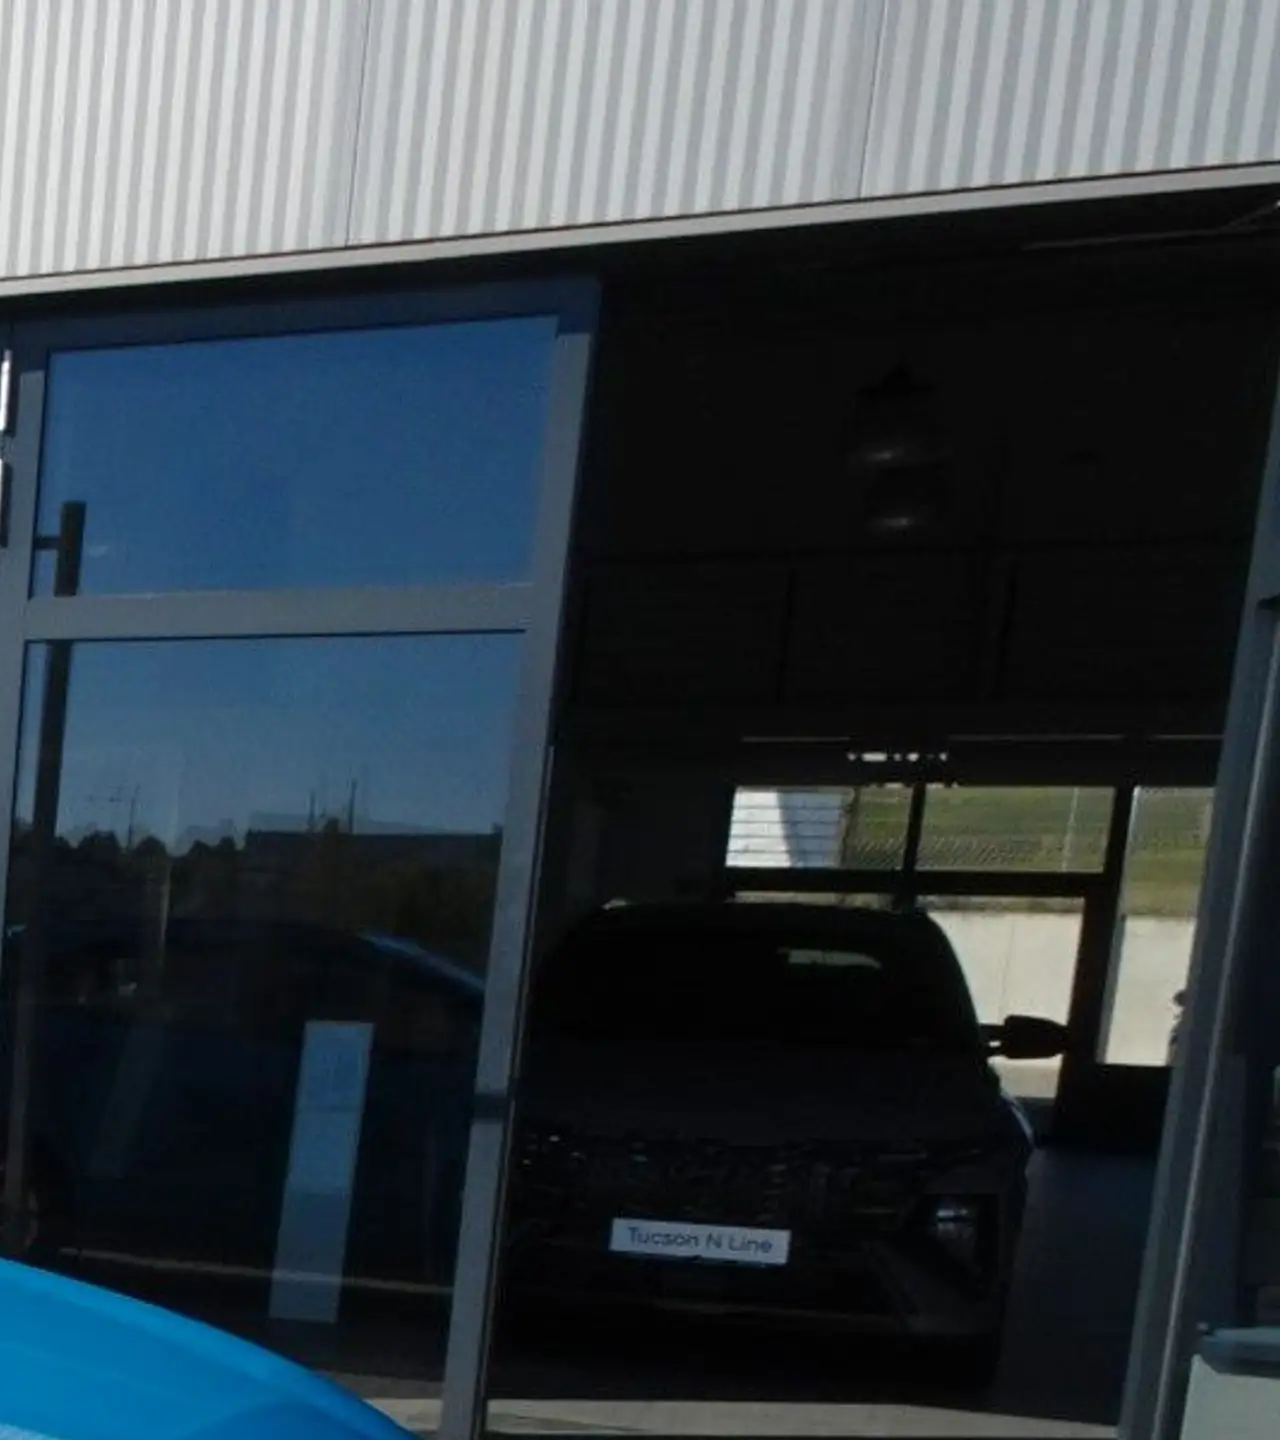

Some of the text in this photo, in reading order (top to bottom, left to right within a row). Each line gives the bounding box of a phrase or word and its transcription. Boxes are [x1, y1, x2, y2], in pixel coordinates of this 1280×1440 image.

[626, 1226, 773, 1254] Tucson N Line
